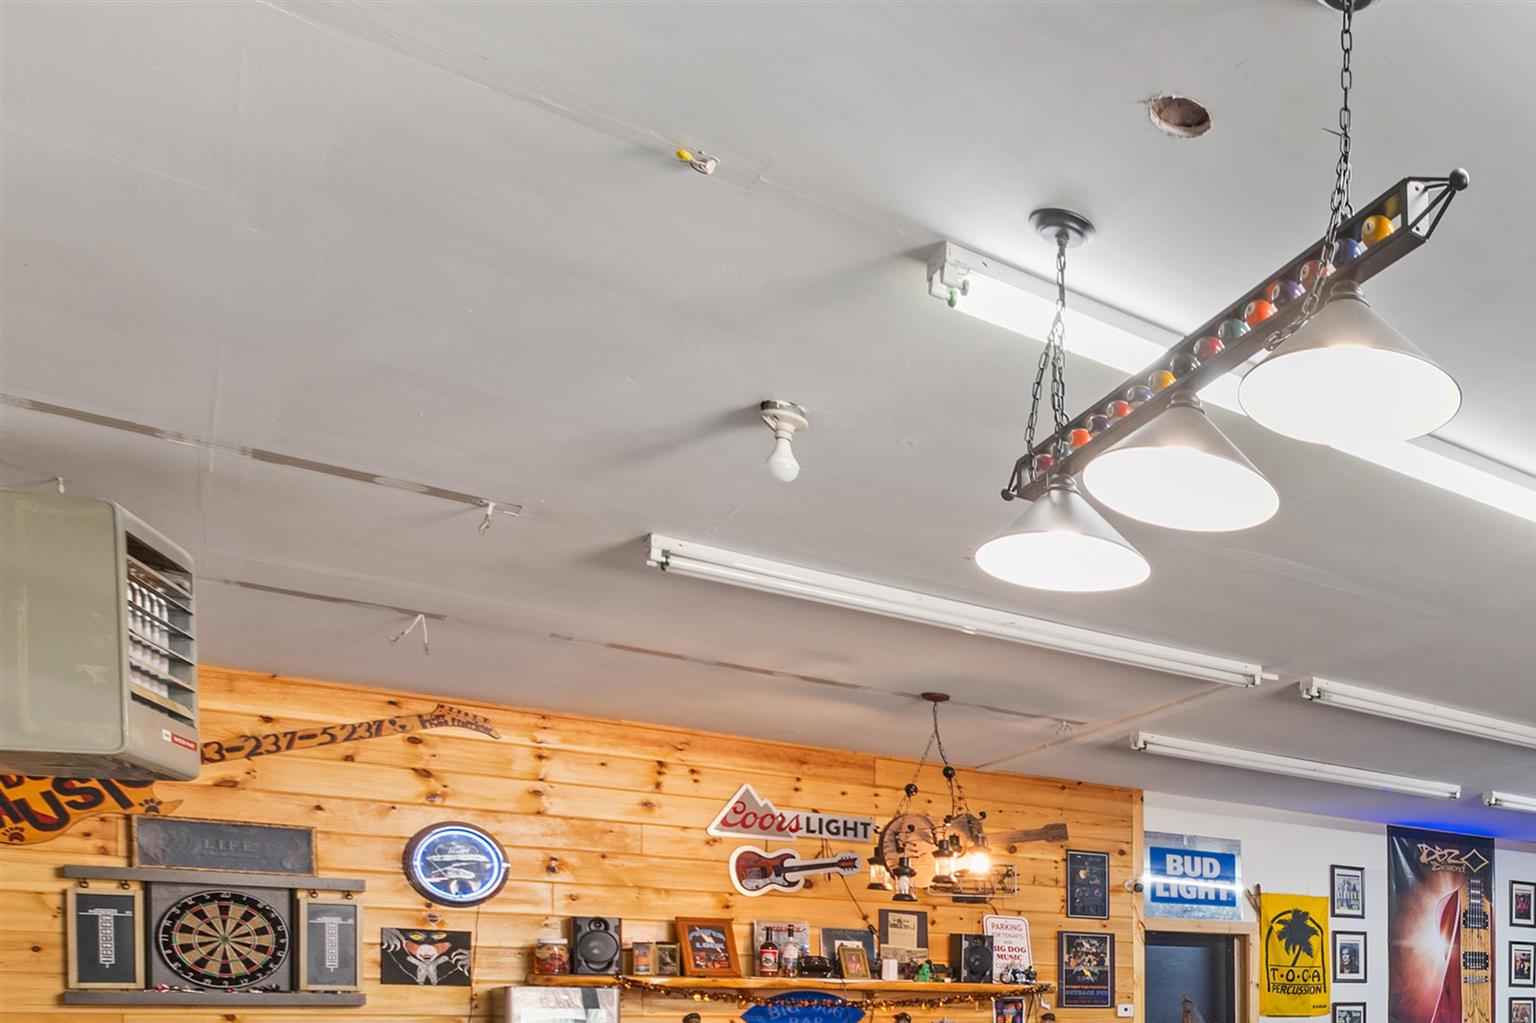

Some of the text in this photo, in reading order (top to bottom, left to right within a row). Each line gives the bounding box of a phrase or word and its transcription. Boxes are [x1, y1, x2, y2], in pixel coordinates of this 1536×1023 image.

[200, 719, 384, 764] 3-237-5237
[0, 775, 155, 832] USI
[719, 800, 871, 840] Coors LIGHT
[1166, 854, 1220, 878] BUD
[1155, 879, 1231, 901] LIGHT
[991, 922, 1022, 931] PARKING
[1271, 984, 1322, 995] PERCUSSION
